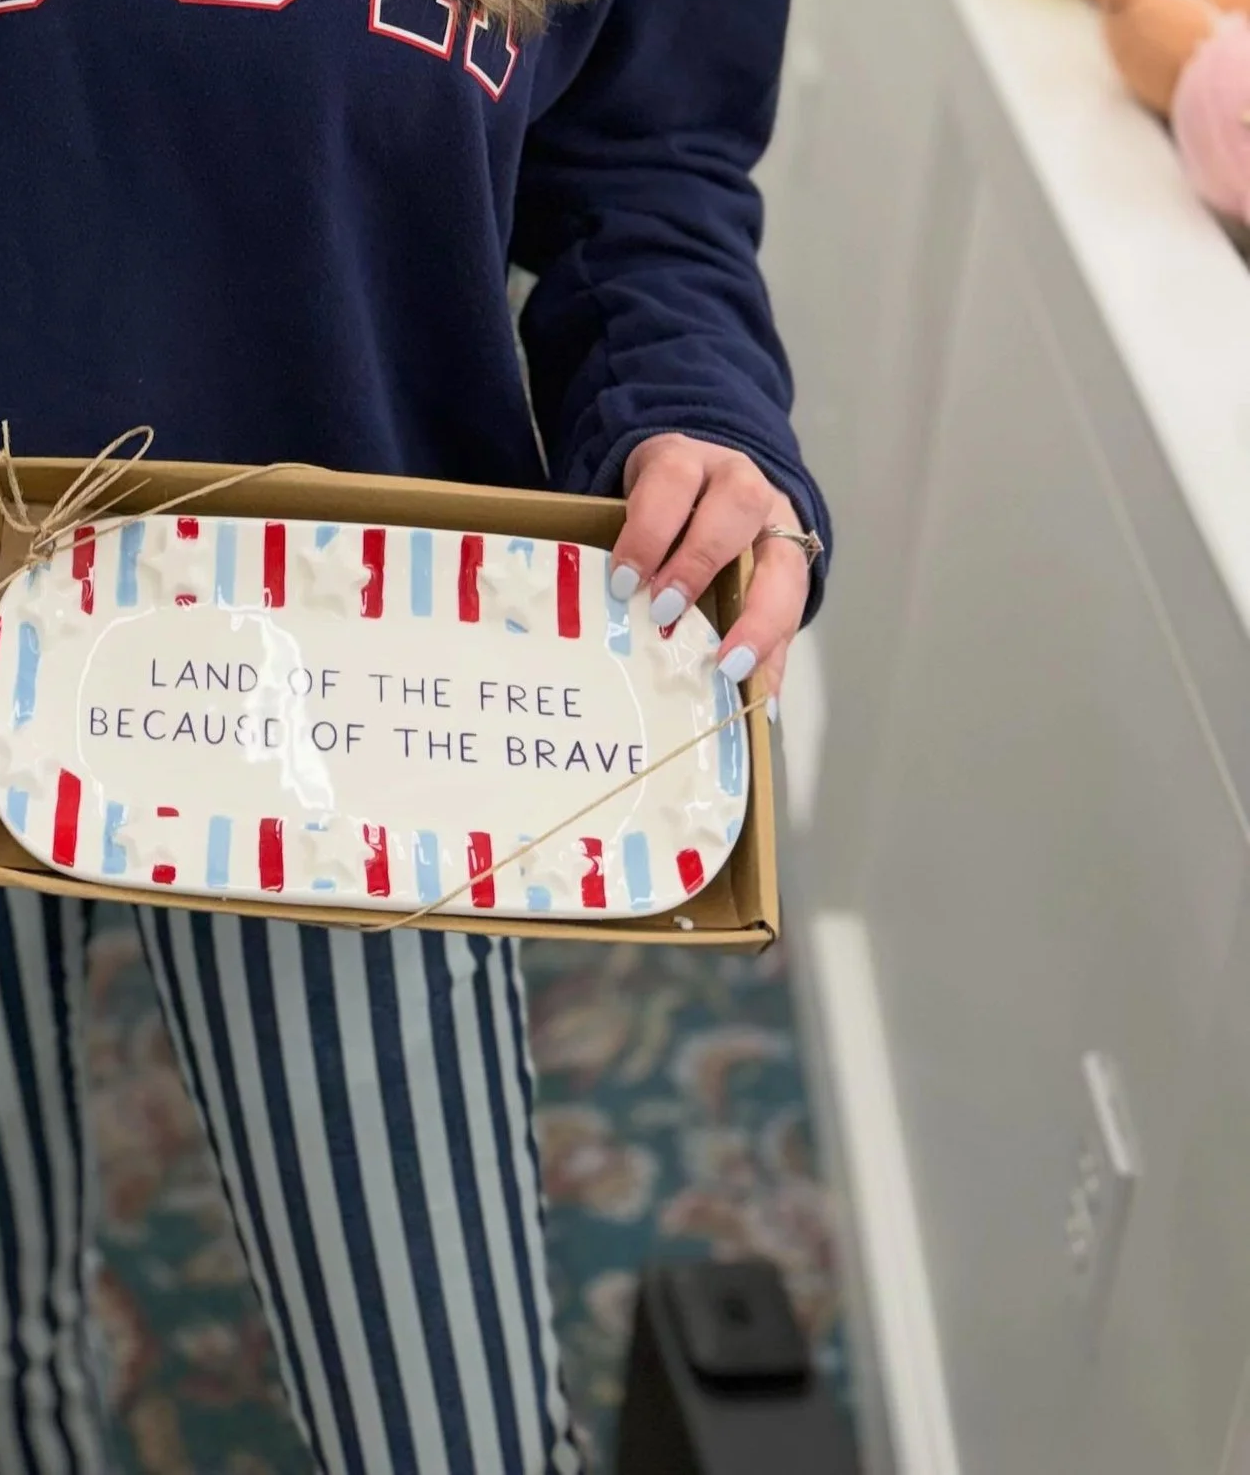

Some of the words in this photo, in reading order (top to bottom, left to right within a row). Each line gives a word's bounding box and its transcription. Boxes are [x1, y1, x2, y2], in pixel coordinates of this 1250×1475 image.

[150, 657, 260, 693] LAND
[286, 666, 341, 700] OF
[367, 673, 451, 709] THE
[479, 680, 583, 718] FREE
[311, 720, 365, 754] OF
[392, 727, 478, 764] THE
[505, 735, 644, 775] BRAVE
